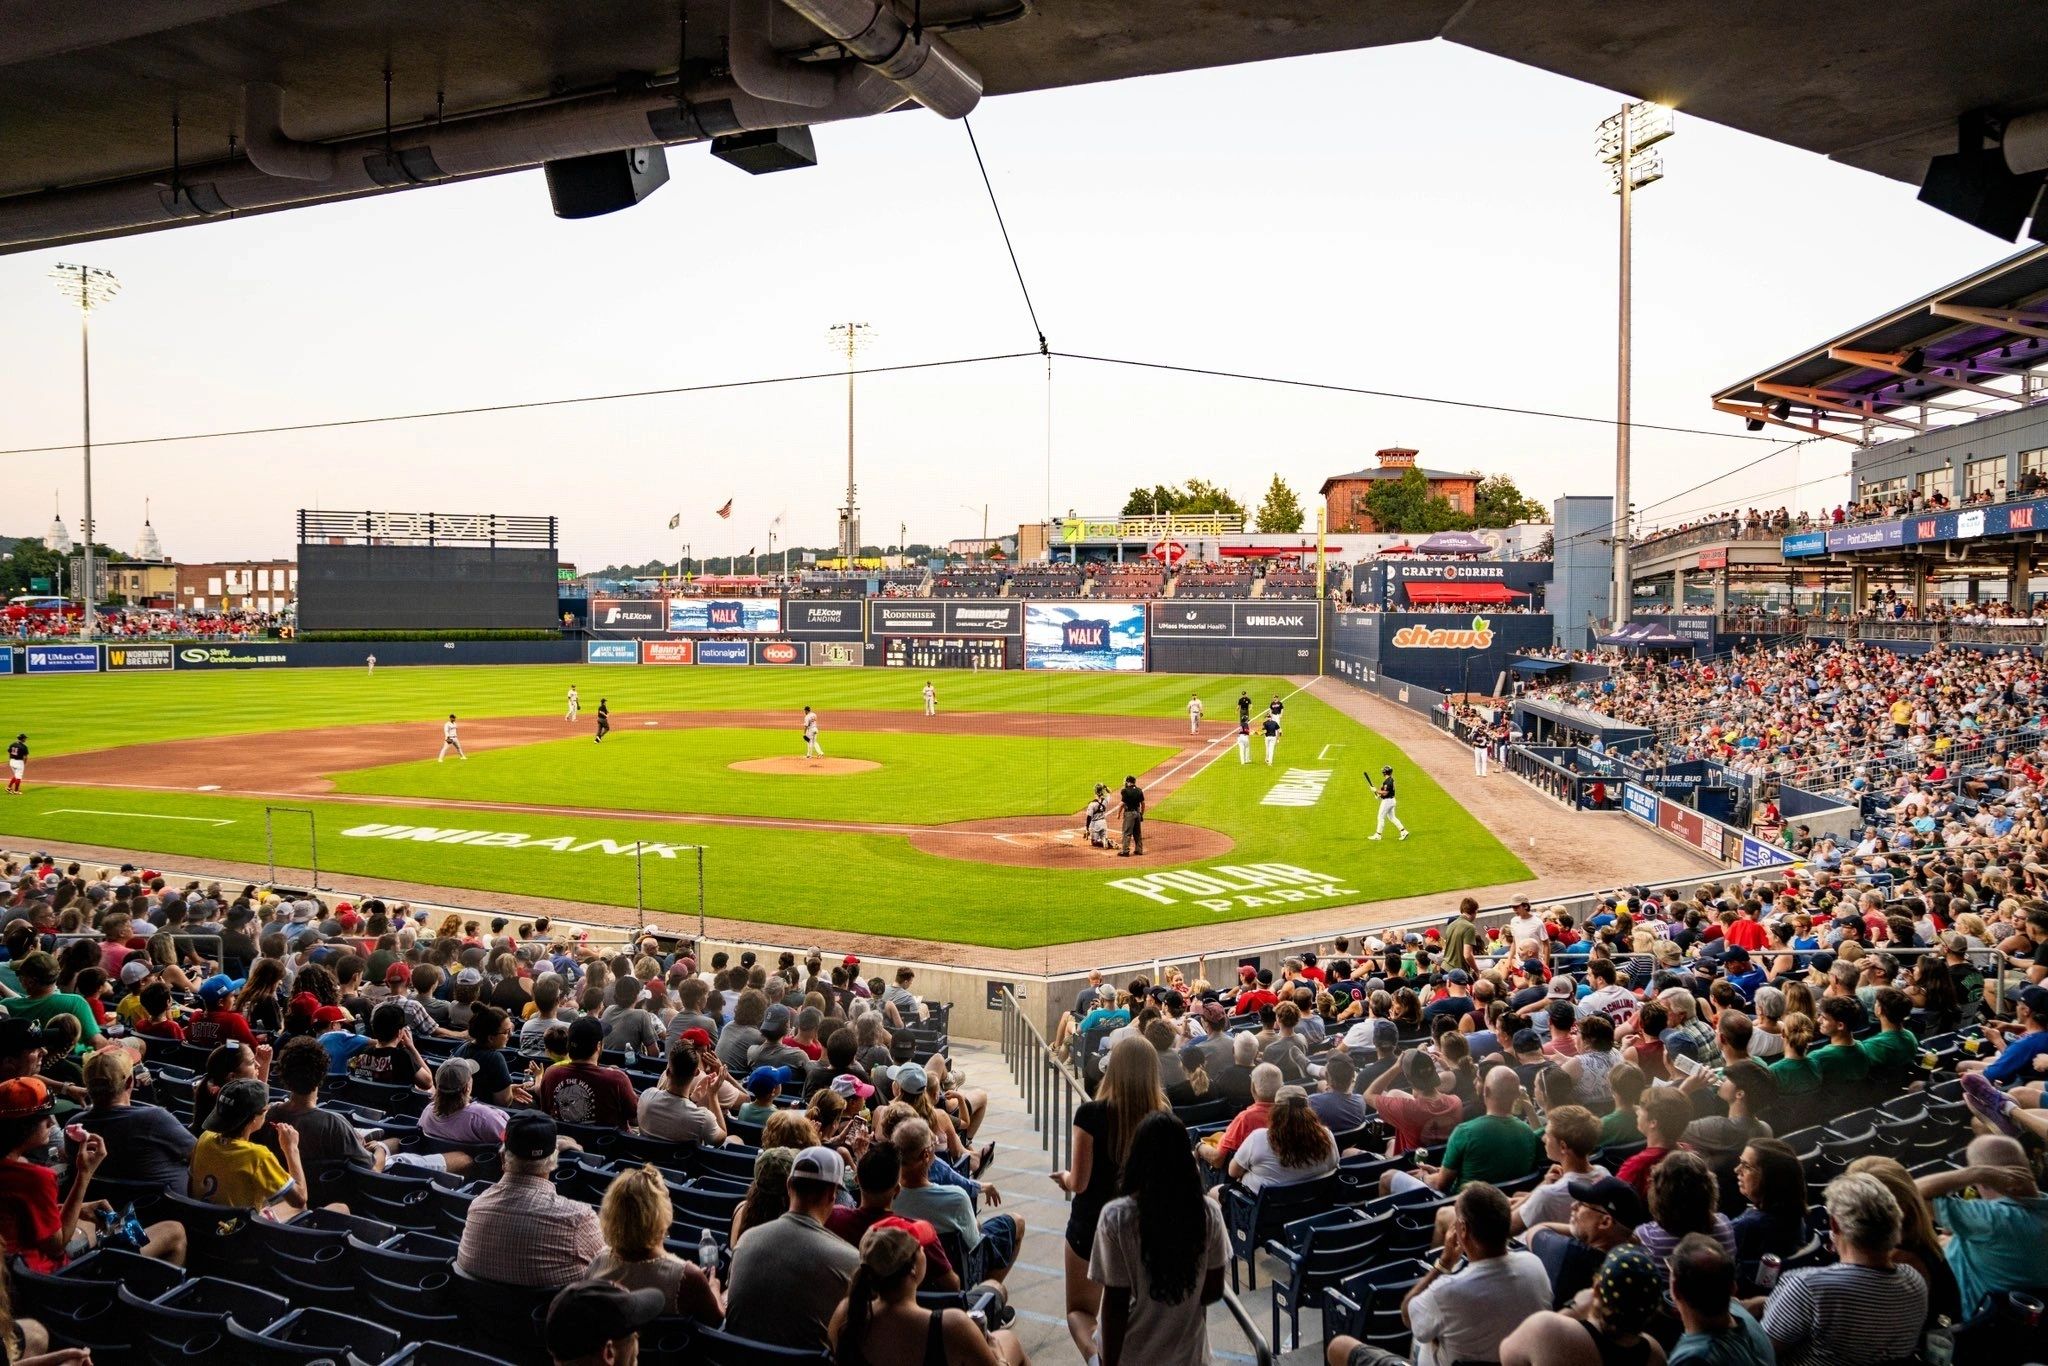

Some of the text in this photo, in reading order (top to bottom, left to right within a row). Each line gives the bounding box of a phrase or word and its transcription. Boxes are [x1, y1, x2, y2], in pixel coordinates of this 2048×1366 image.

[2009, 507, 2034, 529] WALK
[1917, 520, 1936, 539] WALK
[1402, 567, 1504, 577] CRAFT CORNER
[711, 609, 738, 623] WALK
[883, 609, 936, 619] RODENHISER
[1246, 616, 1304, 626] UNIBANK
[1068, 628, 1102, 646] WALK
[126, 650, 169, 658] WORMTOWN
[210, 649, 230, 657] Simply
[701, 649, 746, 658] nationalgrid
[767, 649, 793, 658] Hood
[126, 658, 164, 666] BREWERY
[340, 823, 703, 859] UNIBANK
[1104, 863, 1348, 904] POLAR
[1193, 884, 1360, 912] PARK
[1602, 999, 1634, 1013] SCHILLING
[554, 1080, 564, 1093] OFF
[579, 1080, 594, 1096] WALL
[203, 1174, 218, 1200] 2
